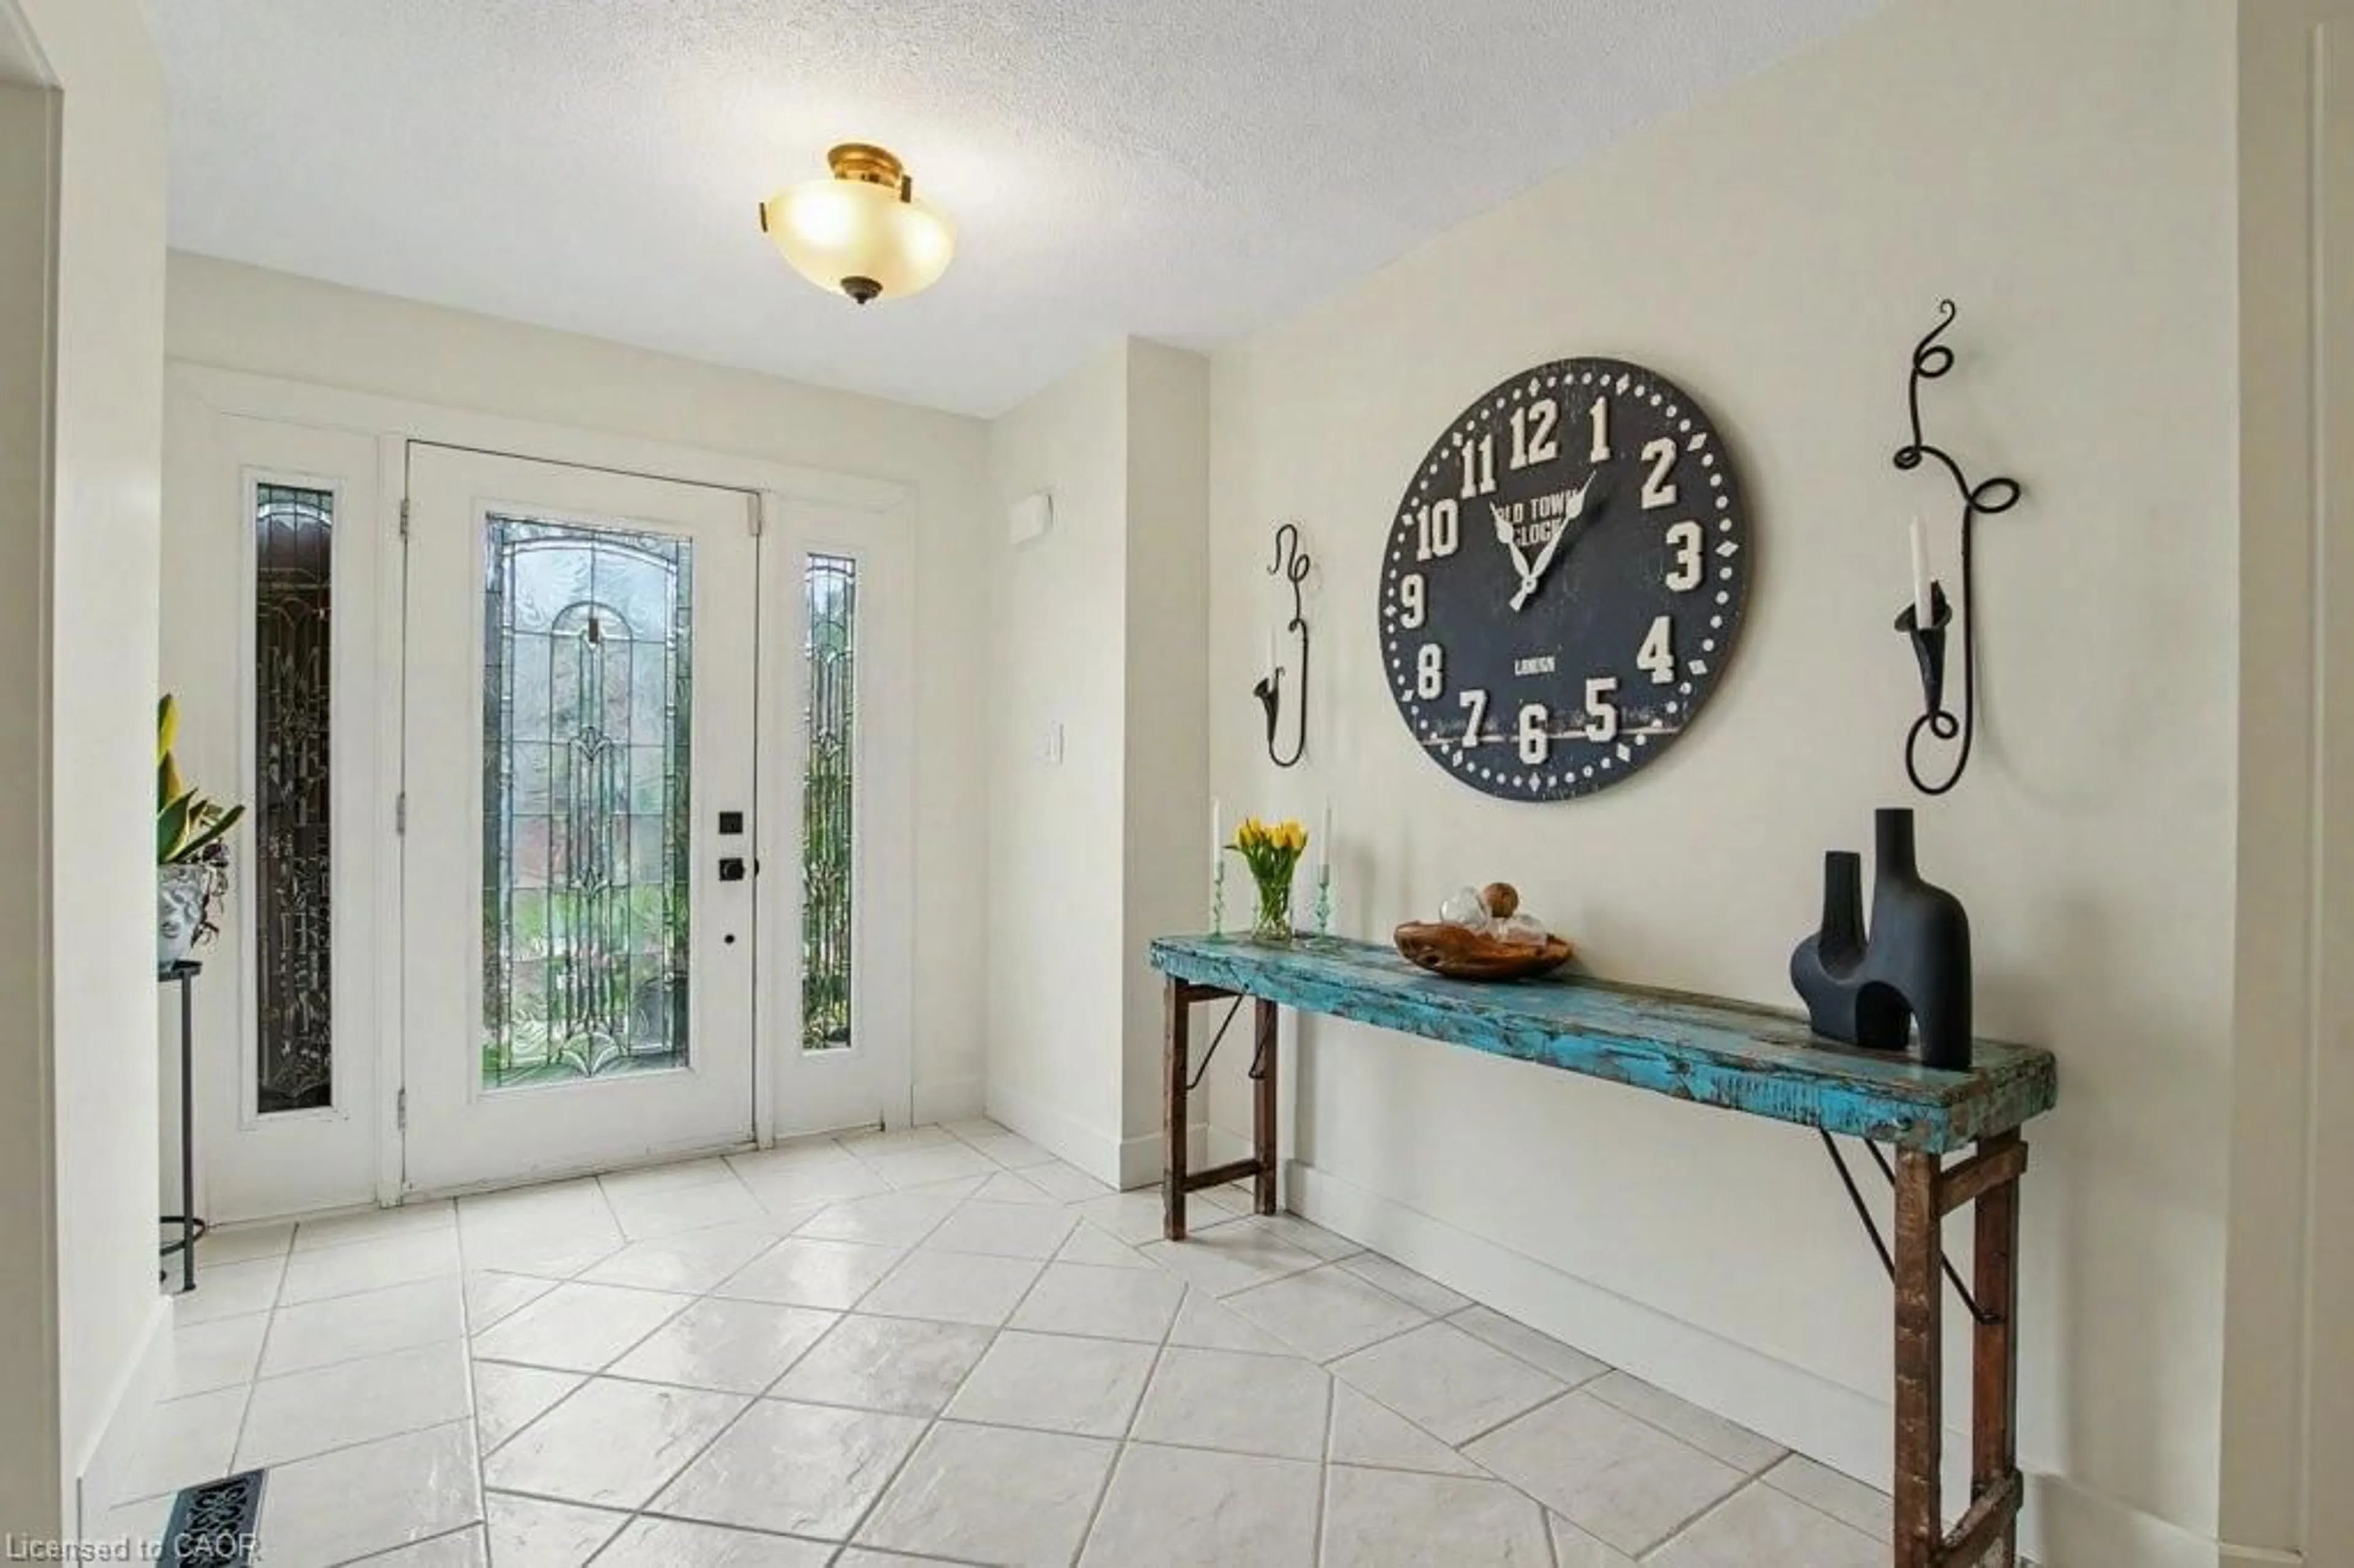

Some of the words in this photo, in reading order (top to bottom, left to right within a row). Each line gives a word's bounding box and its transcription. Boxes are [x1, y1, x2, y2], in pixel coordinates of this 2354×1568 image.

[1509, 398, 1558, 470] 12
[1590, 396, 1610, 462] 1
[1461, 434, 1496, 499] 11
[1641, 437, 1677, 509] 2
[1416, 498, 1458, 561] 10
[1666, 522, 1703, 592] 3
[1401, 574, 1425, 629] 9
[1418, 644, 1442, 700] 8
[1636, 616, 1675, 683] 4
[1460, 690, 1486, 748] 7
[1519, 704, 1548, 765] 6
[1585, 678, 1617, 742] 5
